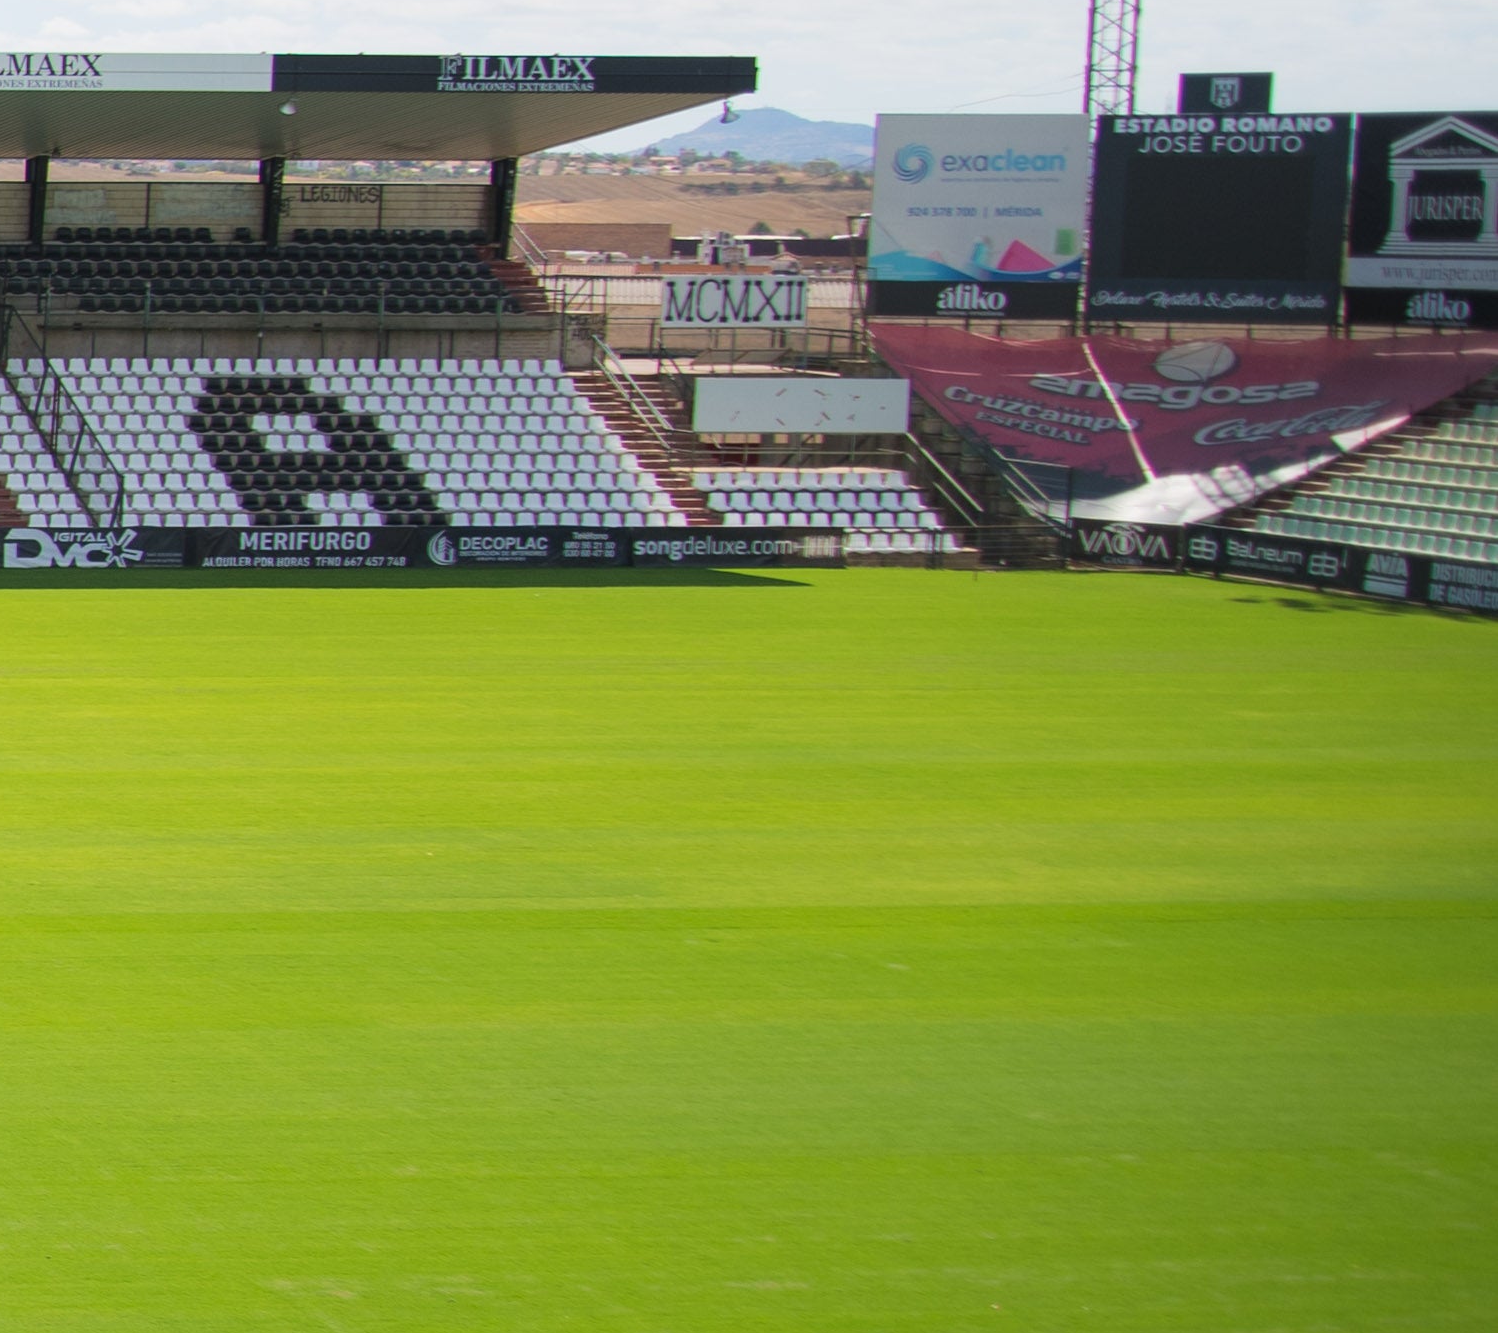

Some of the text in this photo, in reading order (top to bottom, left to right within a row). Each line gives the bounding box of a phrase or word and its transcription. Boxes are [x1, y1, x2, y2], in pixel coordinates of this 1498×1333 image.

[438, 56, 595, 81] FILMAEX
[27, 77, 102, 88] EXTREMEÑAS
[437, 81, 594, 92] FILMACIONES EXTREMEÑAS
[1113, 116, 1334, 134] ESTADIO ROMANO
[1138, 133, 1303, 153] JOSÉ FOUTO
[940, 148, 1067, 172] exaclean
[1408, 195, 1483, 220] JURISPER
[664, 279, 806, 323] MCMXII
[943, 386, 1140, 433] Cruzcampo
[974, 410, 1091, 445] ESPECIAL
[239, 531, 372, 552] MERIFURGO
[459, 536, 548, 551] DECOPLAC
[634, 535, 793, 561] songdeluxe.com
[203, 556, 252, 568] ALQUILER
[254, 556, 274, 567] POR
[277, 556, 311, 567] HORAS
